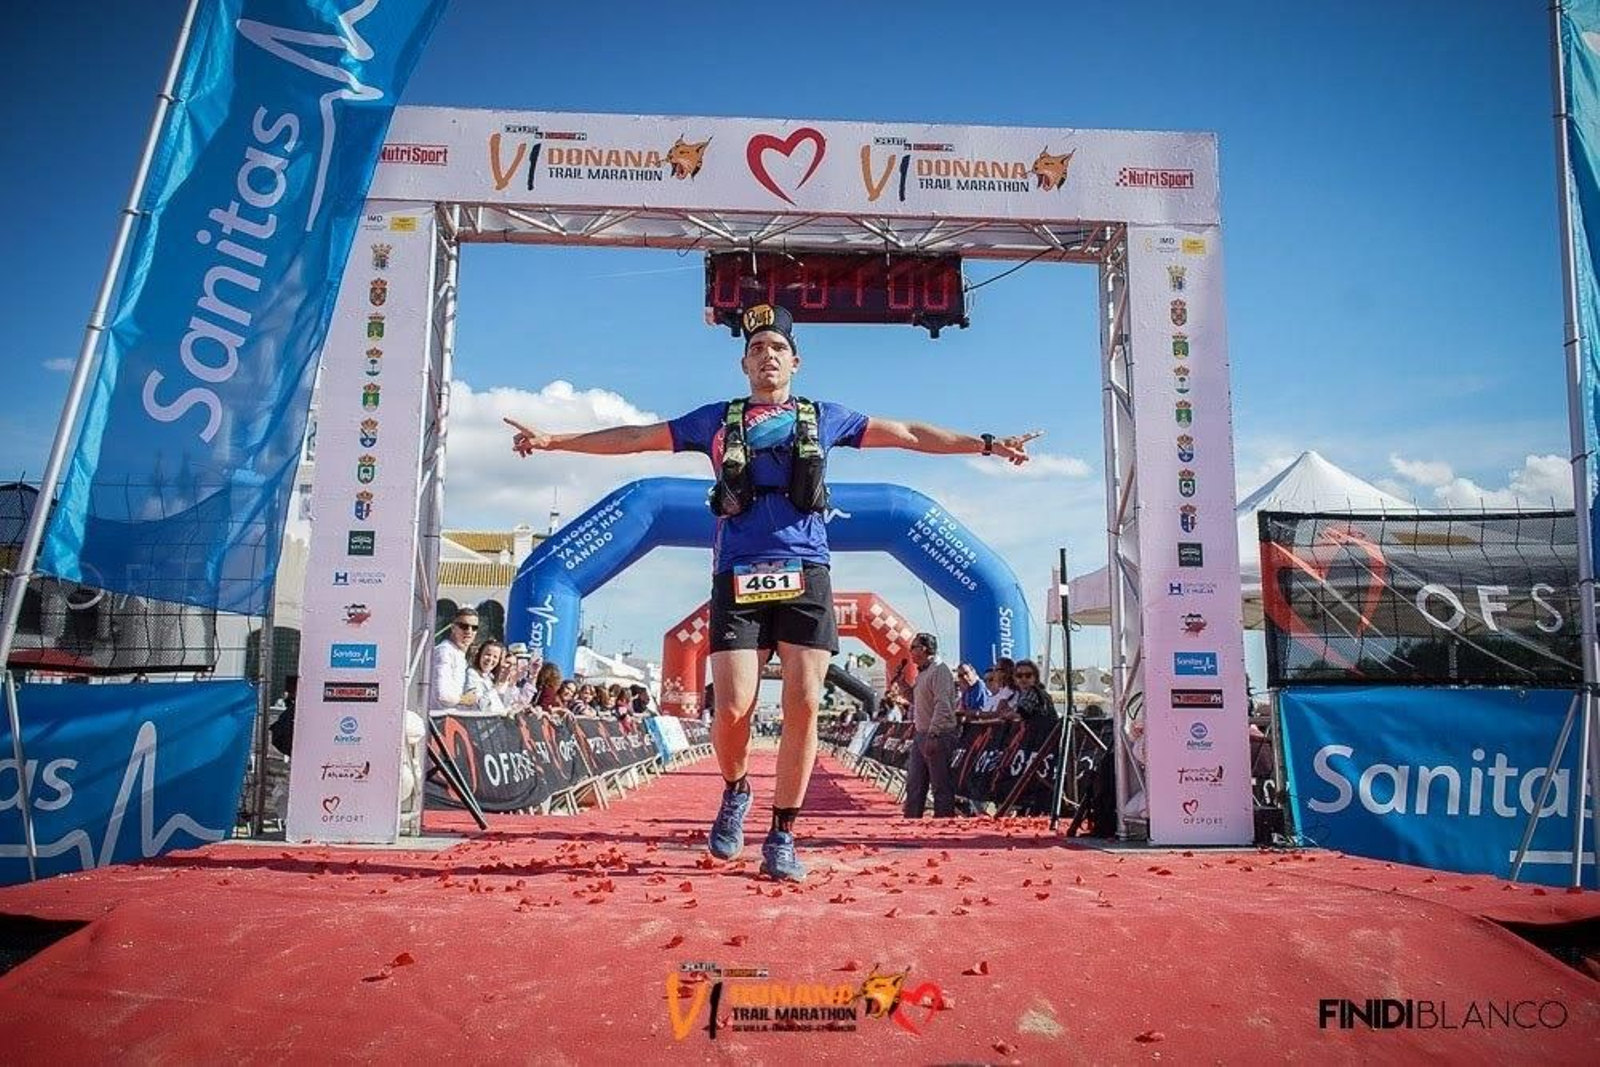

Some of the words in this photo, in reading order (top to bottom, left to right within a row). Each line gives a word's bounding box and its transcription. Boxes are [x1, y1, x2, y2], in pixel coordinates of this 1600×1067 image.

[548, 168, 584, 180] TRAIL
[587, 169, 663, 182] MARATHON
[1127, 168, 1194, 188] NutriSport
[919, 178, 953, 191] TRAIL
[957, 179, 1030, 193] MARATHON
[142, 106, 300, 443] Sanitas
[924, 512, 937, 526] TE
[557, 547, 574, 560] YA
[575, 527, 599, 547] NOS
[600, 509, 623, 529] HAS
[915, 520, 970, 569] NOSOTROS
[566, 532, 613, 569] GANADO
[907, 527, 922, 543] TE
[921, 543, 977, 590] ANIMAMOS
[746, 575, 789, 590] 461
[333, 649, 360, 658] Sanitas
